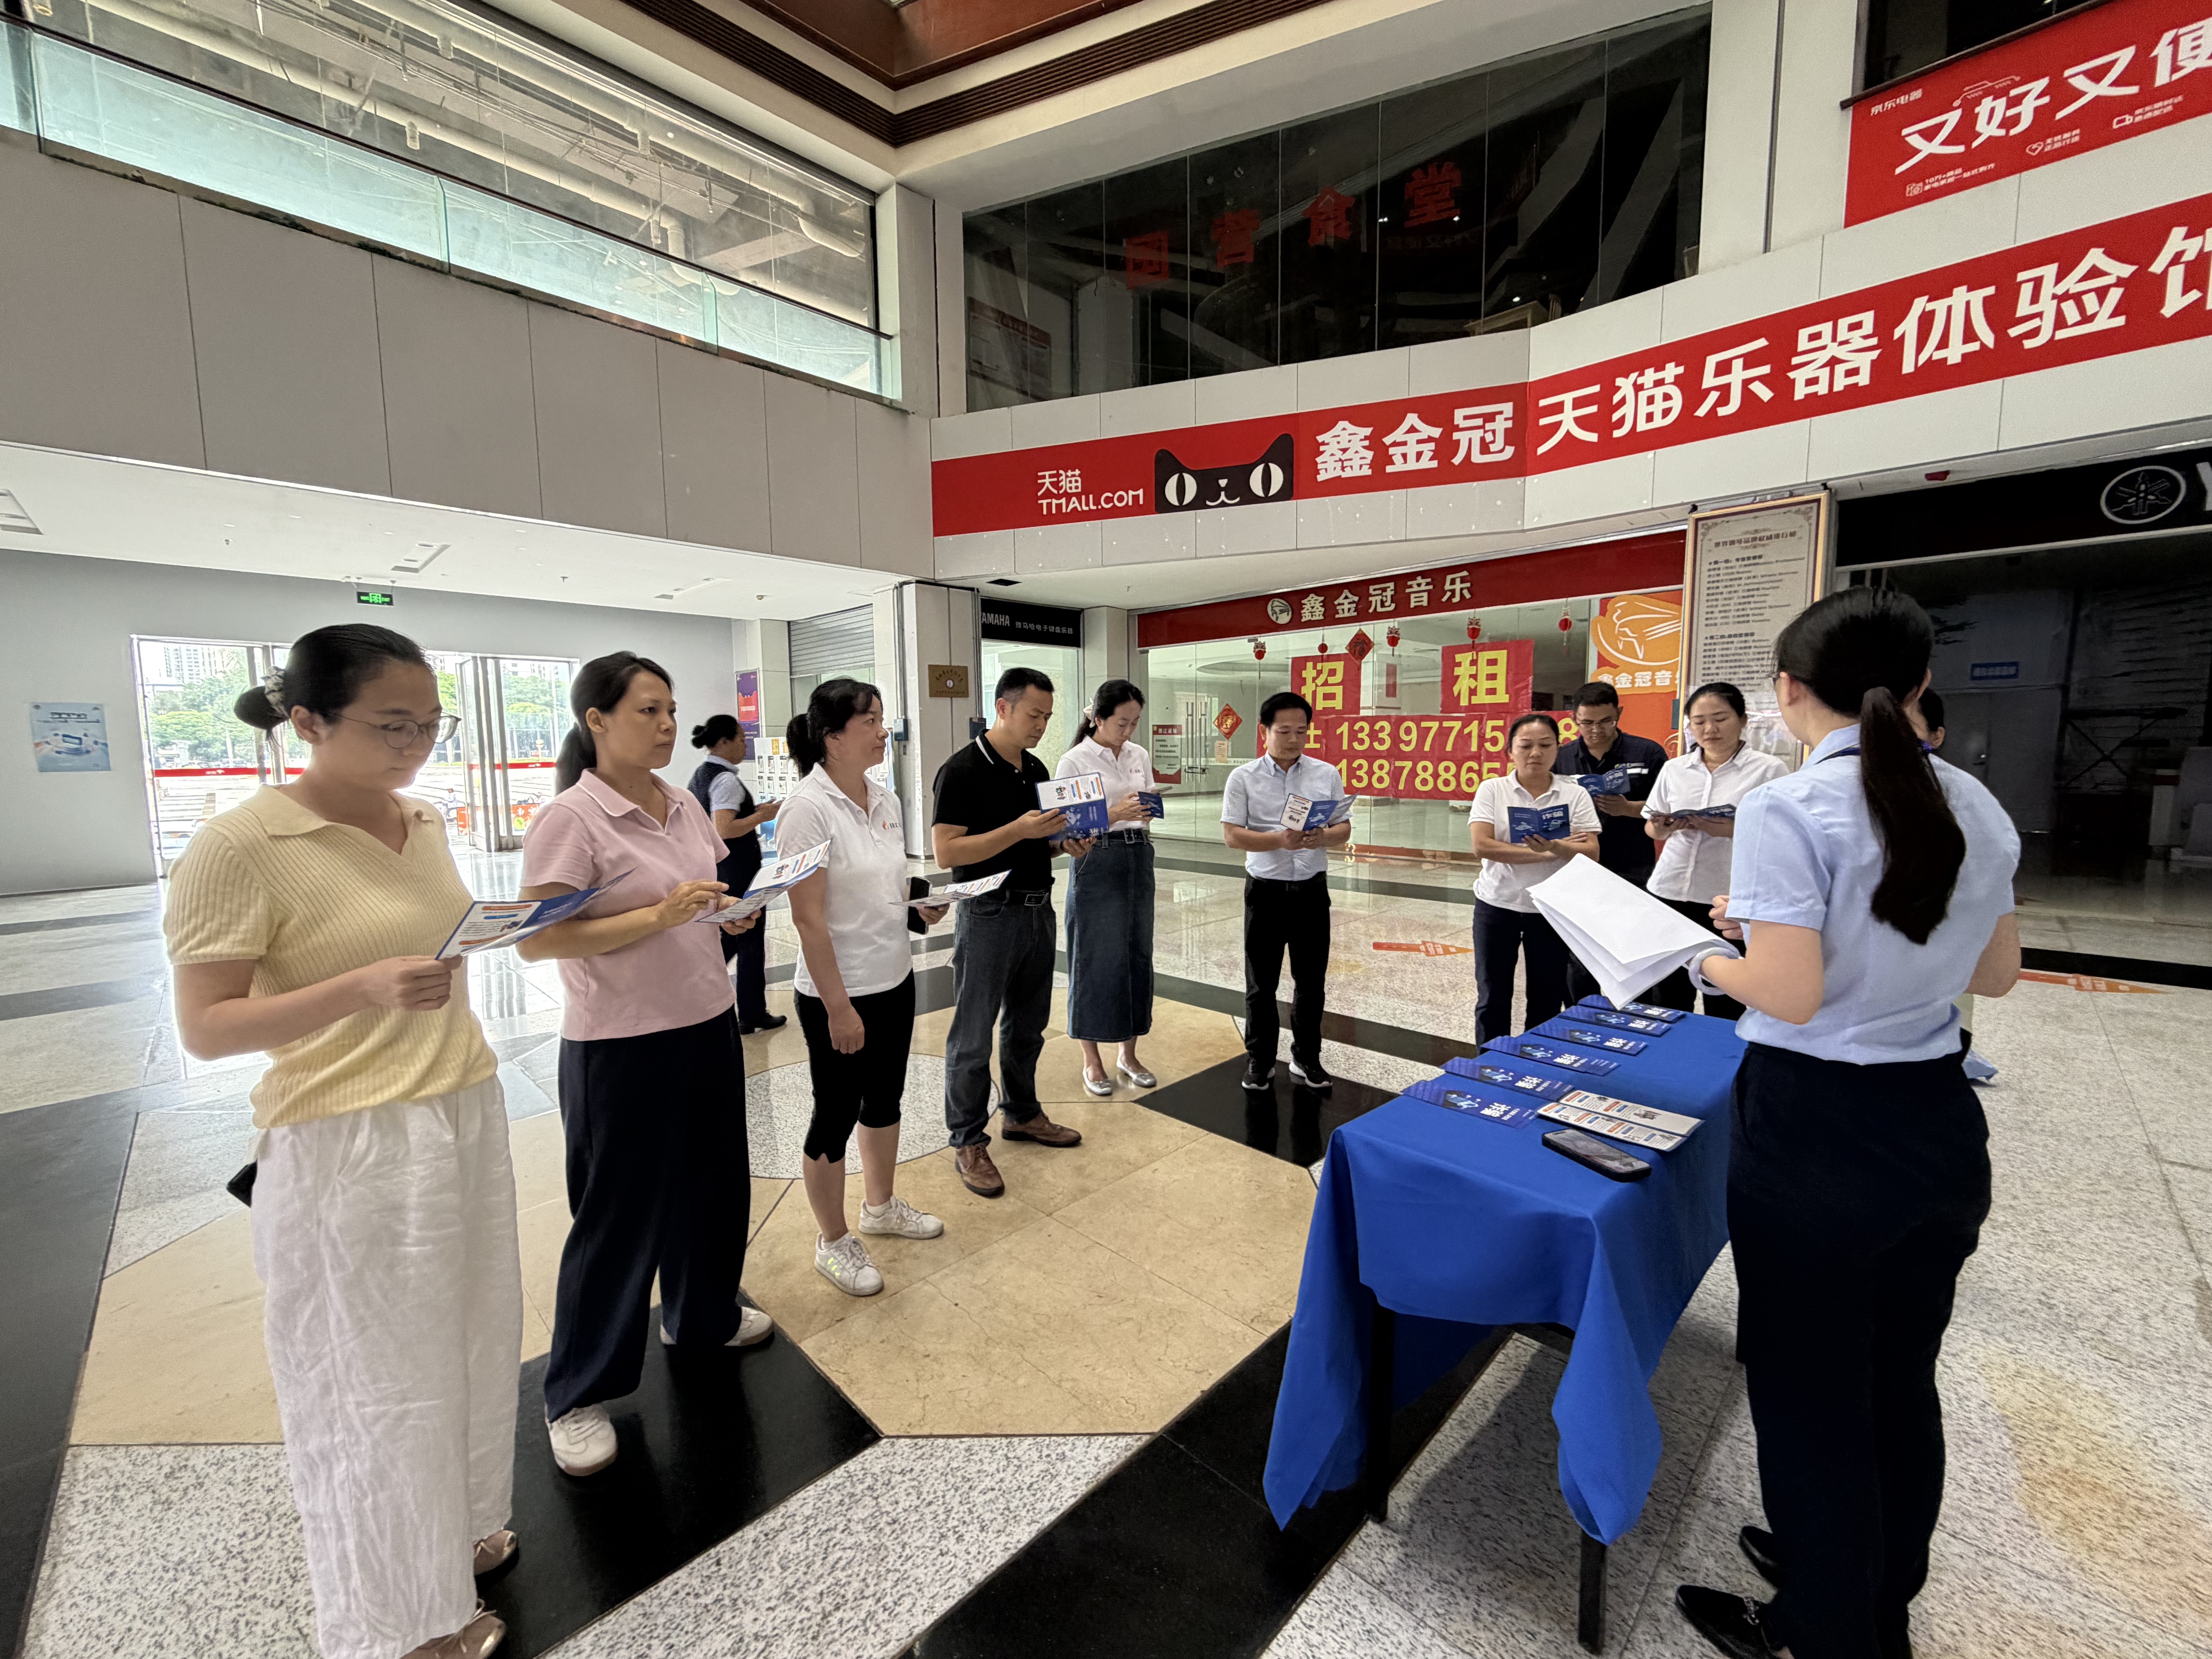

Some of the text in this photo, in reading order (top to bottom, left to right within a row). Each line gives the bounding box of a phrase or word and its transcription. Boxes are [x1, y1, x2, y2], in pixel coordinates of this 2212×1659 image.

[1315, 401, 1515, 482] 鑫金冠
[1037, 469, 1081, 496] 天猫
[1038, 488, 1144, 515] TMALL.COM
[1300, 570, 1472, 622] 鑫金冠音乐
[981, 612, 1010, 626] AMAHA
[1302, 650, 1510, 710] 招租
